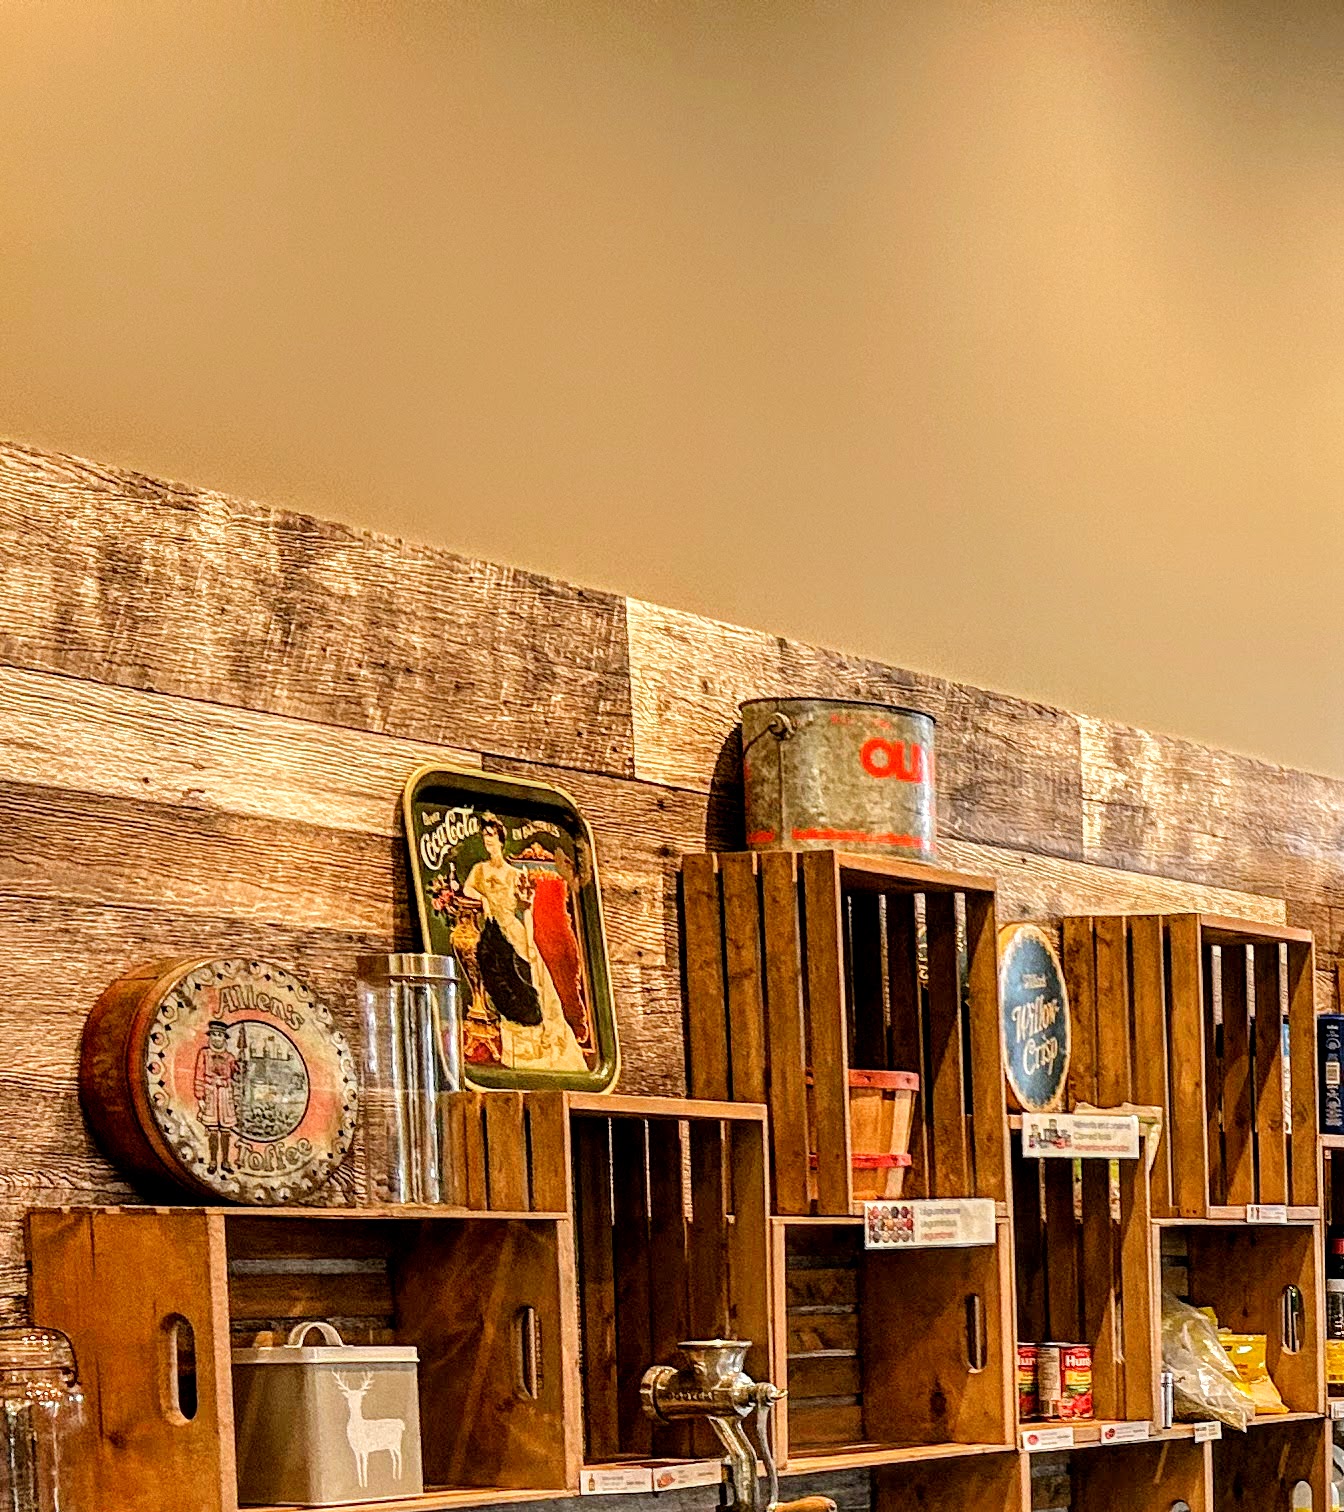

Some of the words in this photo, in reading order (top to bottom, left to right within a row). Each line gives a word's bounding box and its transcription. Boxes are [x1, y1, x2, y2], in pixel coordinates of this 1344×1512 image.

[213, 984, 306, 1031] Allen's
[1022, 1036, 1058, 1076] Crisp
[234, 1138, 313, 1172] Toffee
